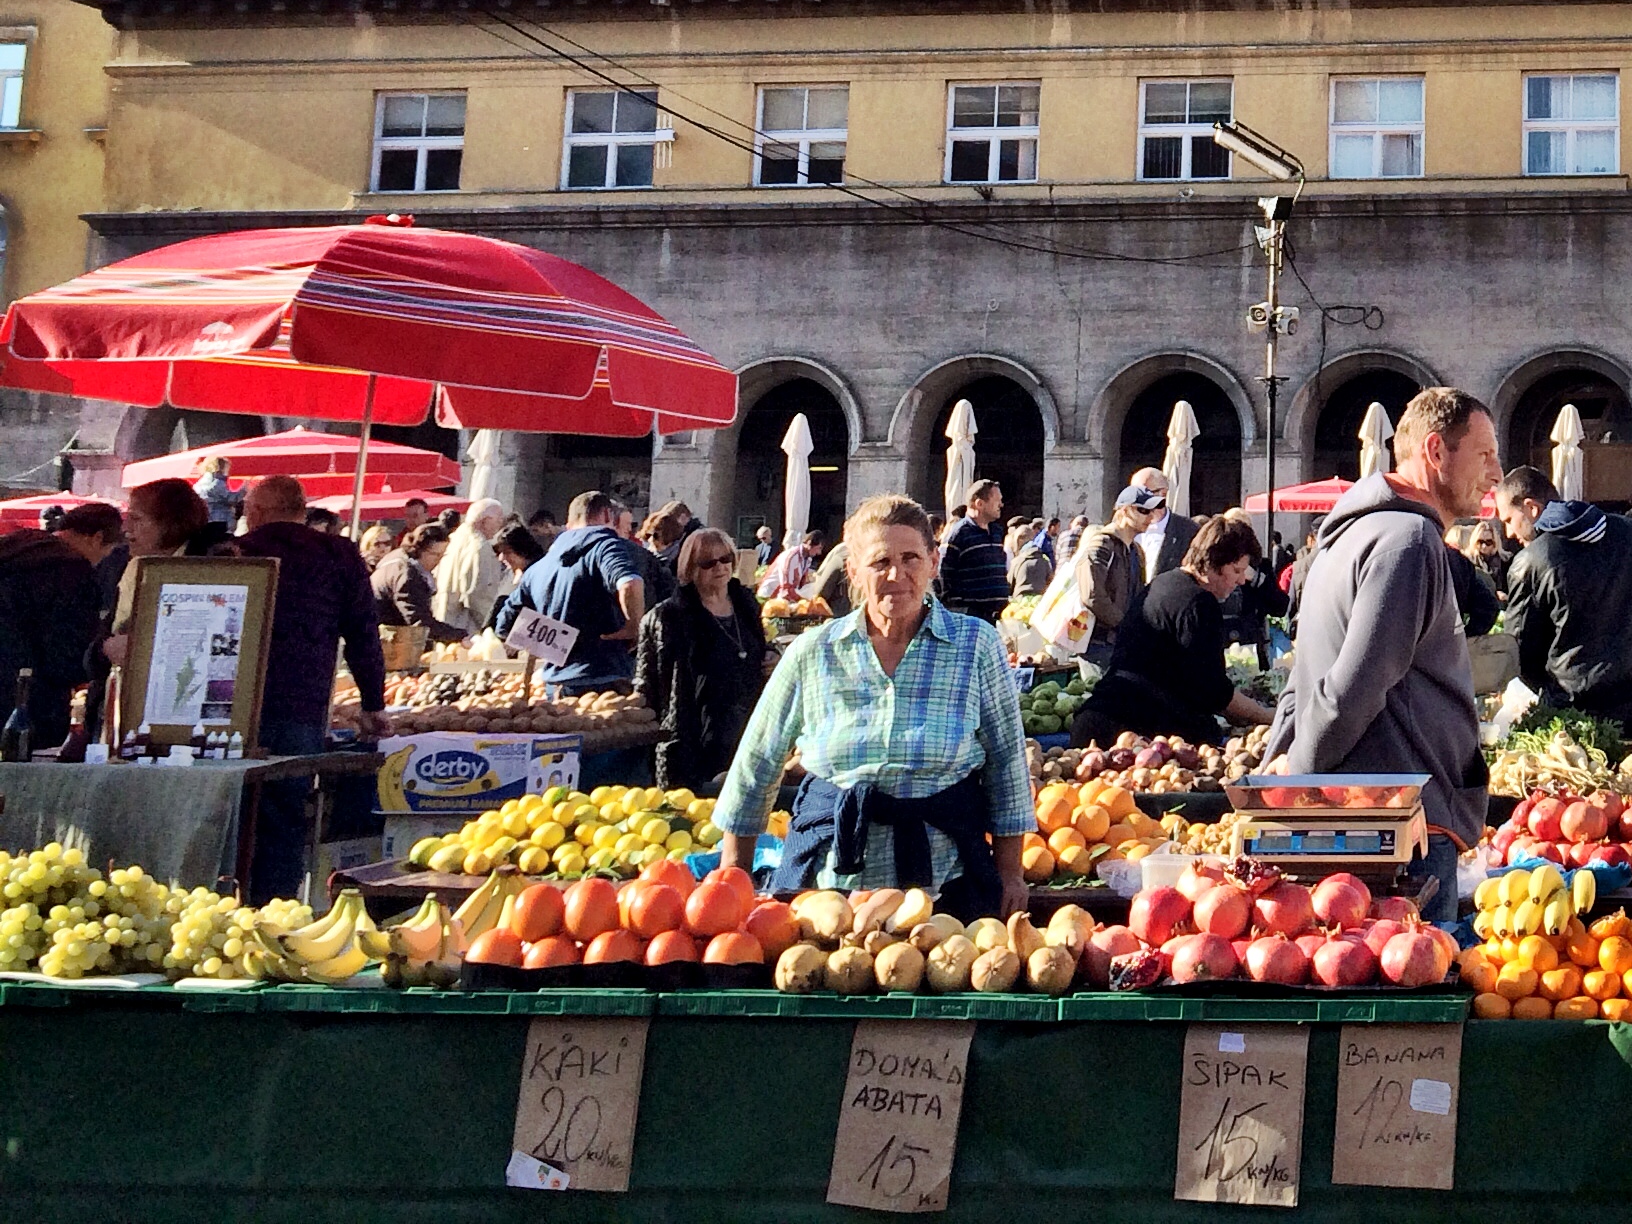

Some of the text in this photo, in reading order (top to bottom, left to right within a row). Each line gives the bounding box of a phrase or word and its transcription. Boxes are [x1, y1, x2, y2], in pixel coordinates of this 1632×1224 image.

[420, 753, 484, 780] derby
[1345, 1043, 1445, 1066] BANANA
[852, 1084, 942, 1120] ABATA
[1195, 1096, 1268, 1182] 15
